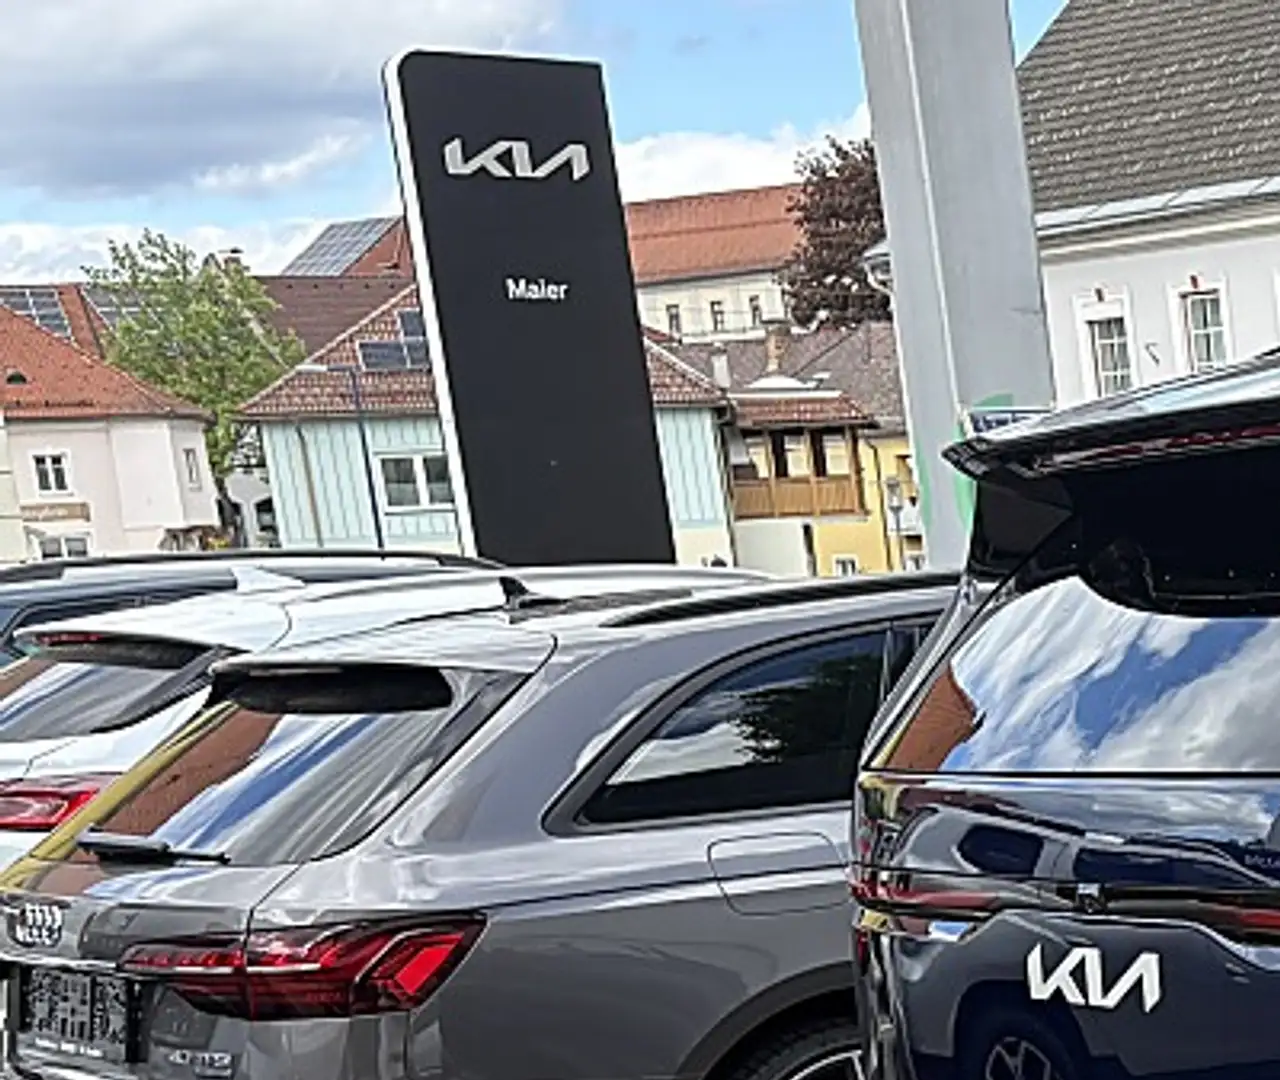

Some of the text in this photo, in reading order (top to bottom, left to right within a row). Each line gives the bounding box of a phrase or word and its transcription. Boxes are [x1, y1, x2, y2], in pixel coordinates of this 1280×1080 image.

[444, 138, 591, 181] KIA
[505, 278, 568, 300] Maier
[1027, 943, 1162, 1013] KIA
